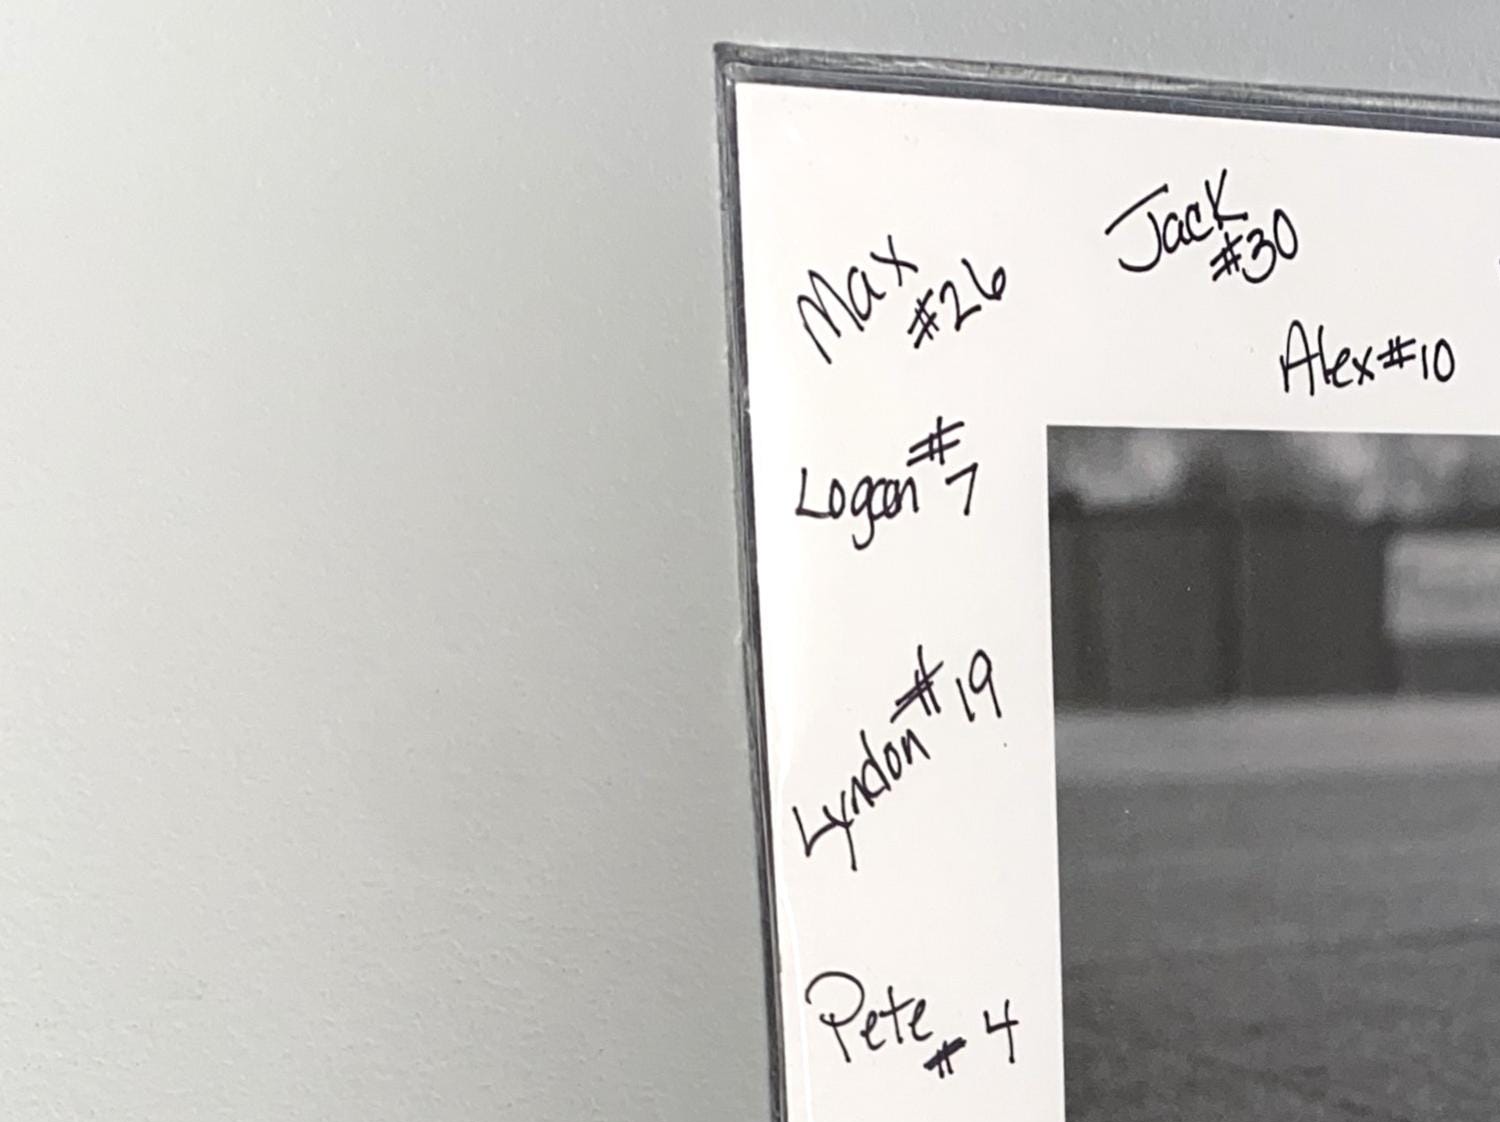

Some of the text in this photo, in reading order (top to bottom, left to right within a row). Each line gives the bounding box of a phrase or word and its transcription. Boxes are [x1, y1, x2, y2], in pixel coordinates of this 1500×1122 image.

[1102, 166, 1251, 275] Jack
[1207, 206, 1300, 286] #30
[795, 232, 921, 367] Max
[905, 256, 1008, 351] #26
[802, 969, 935, 1065] Pete
